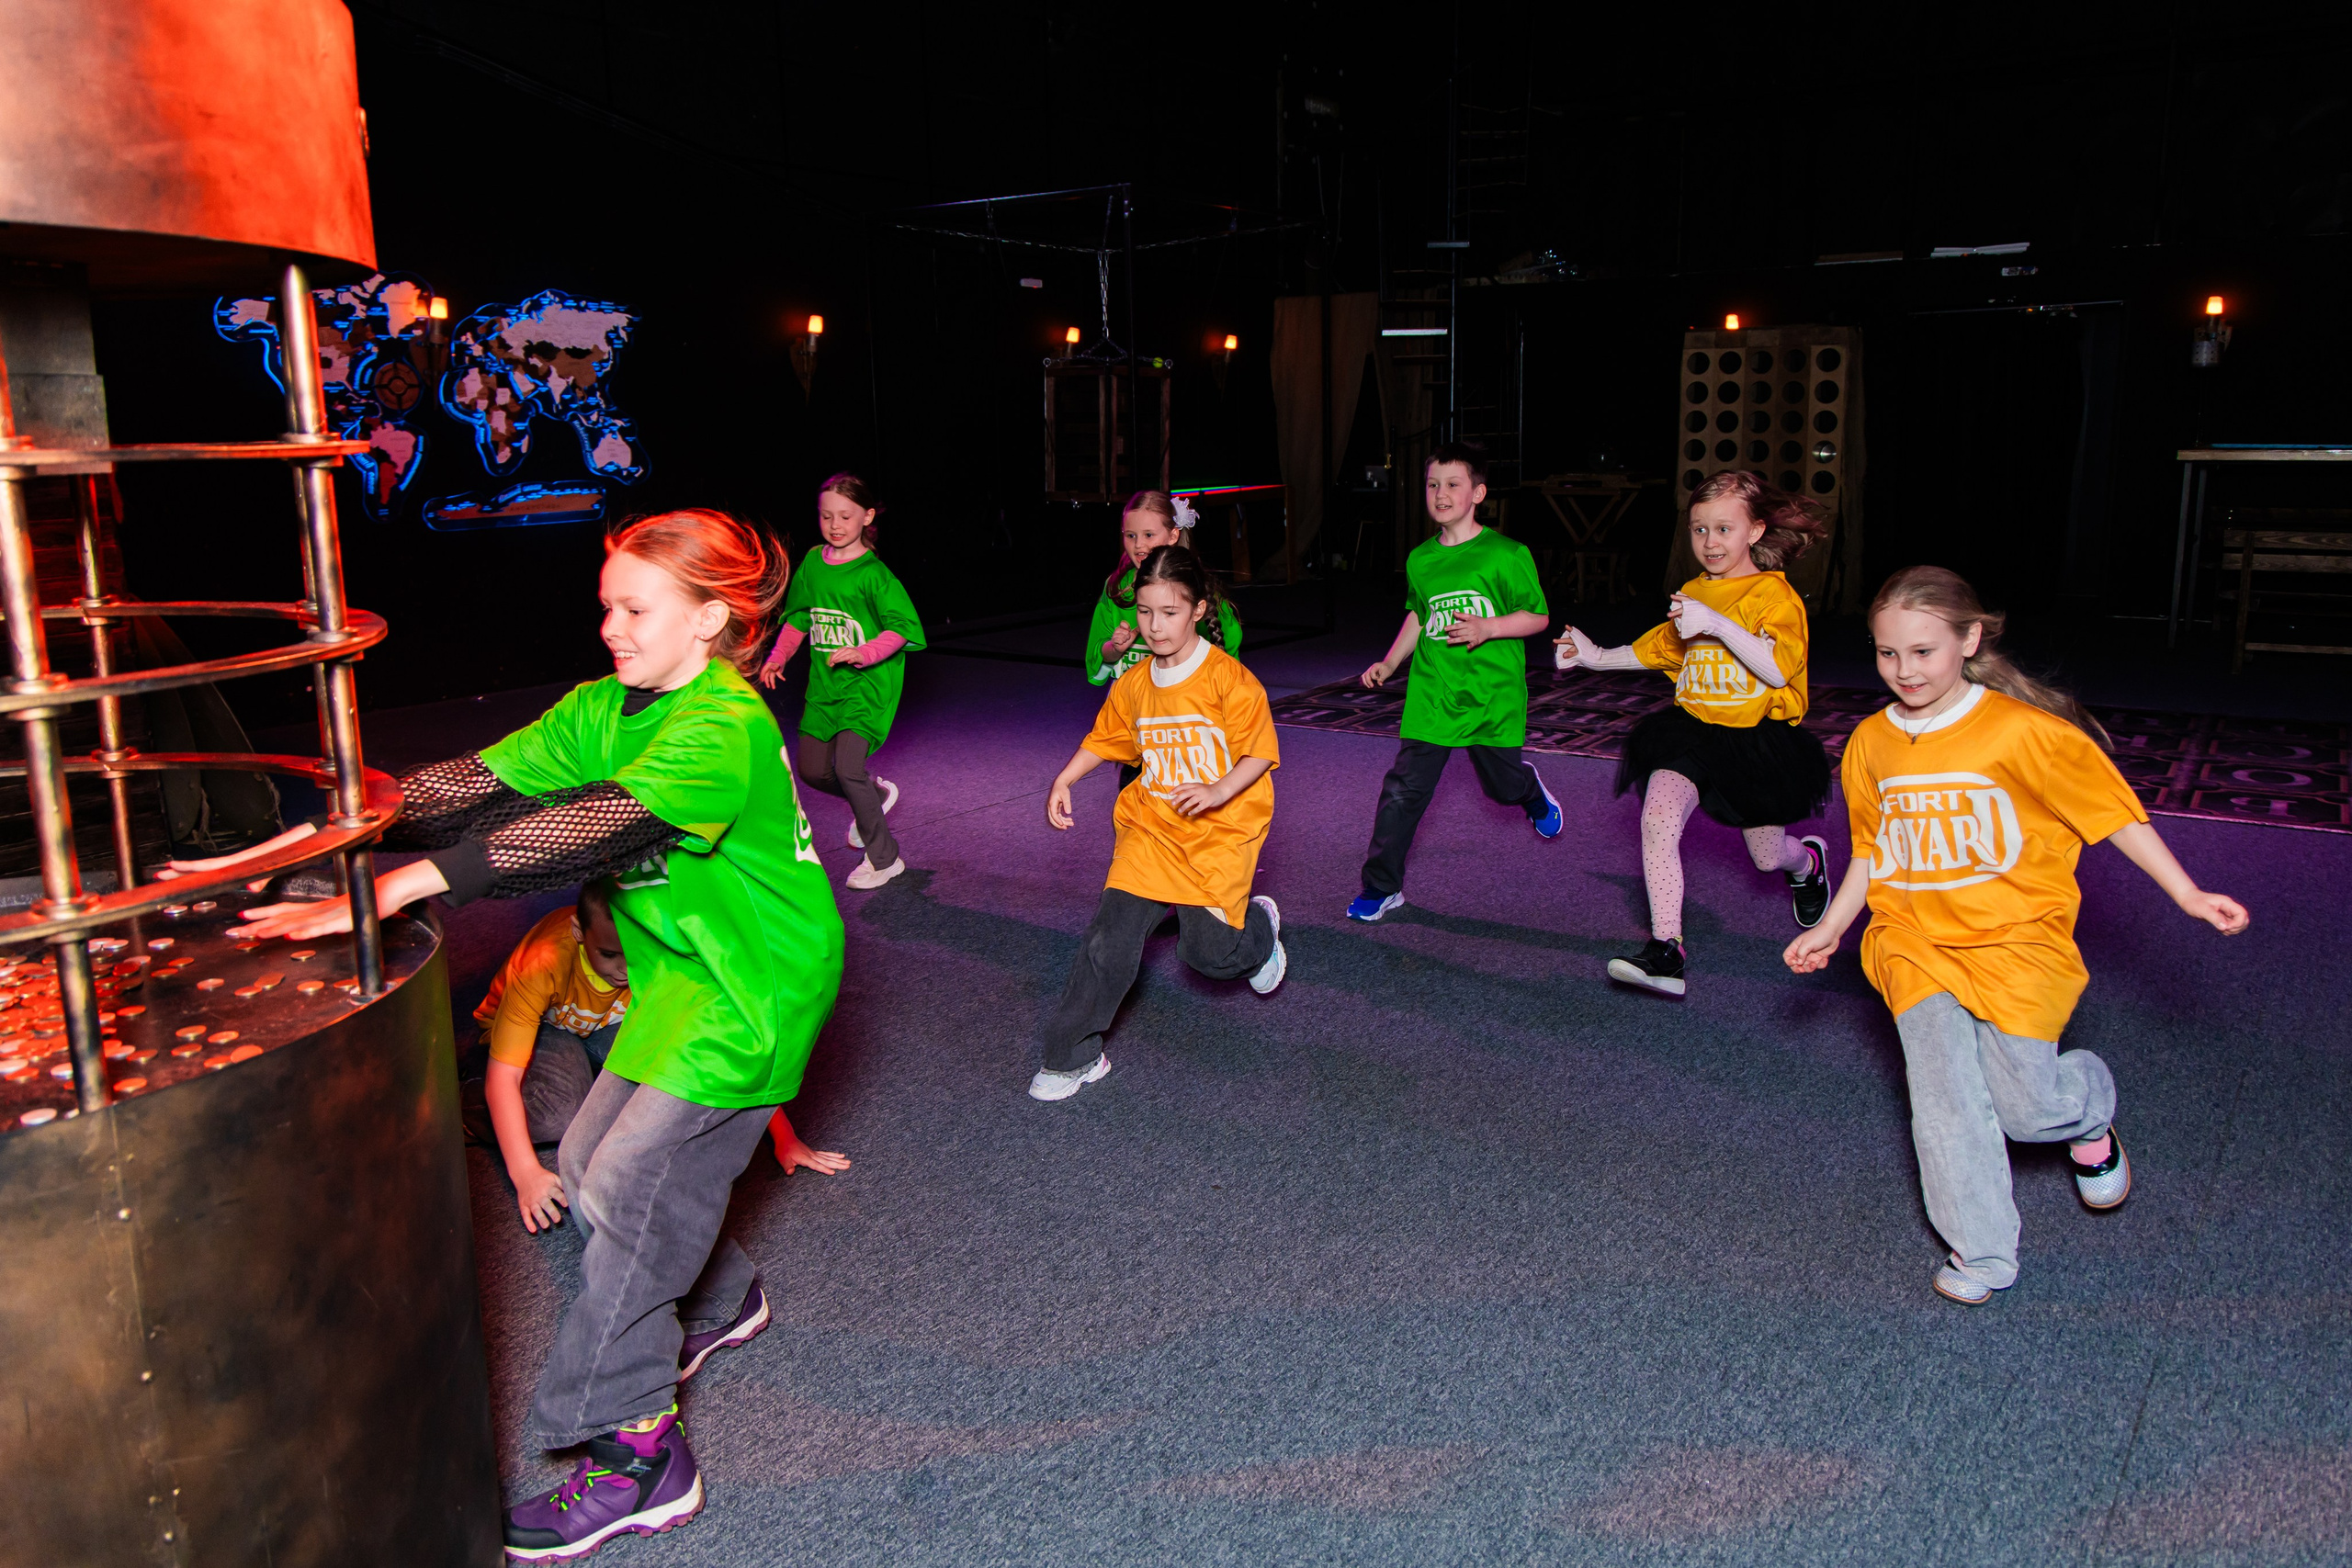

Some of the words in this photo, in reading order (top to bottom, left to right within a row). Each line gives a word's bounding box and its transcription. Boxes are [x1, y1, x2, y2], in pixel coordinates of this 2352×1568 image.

[1434, 596, 1468, 610] FORT
[1139, 726, 1193, 745] FORT
[1140, 725, 1233, 788] OYARD
[1883, 790, 1963, 815] FORT
